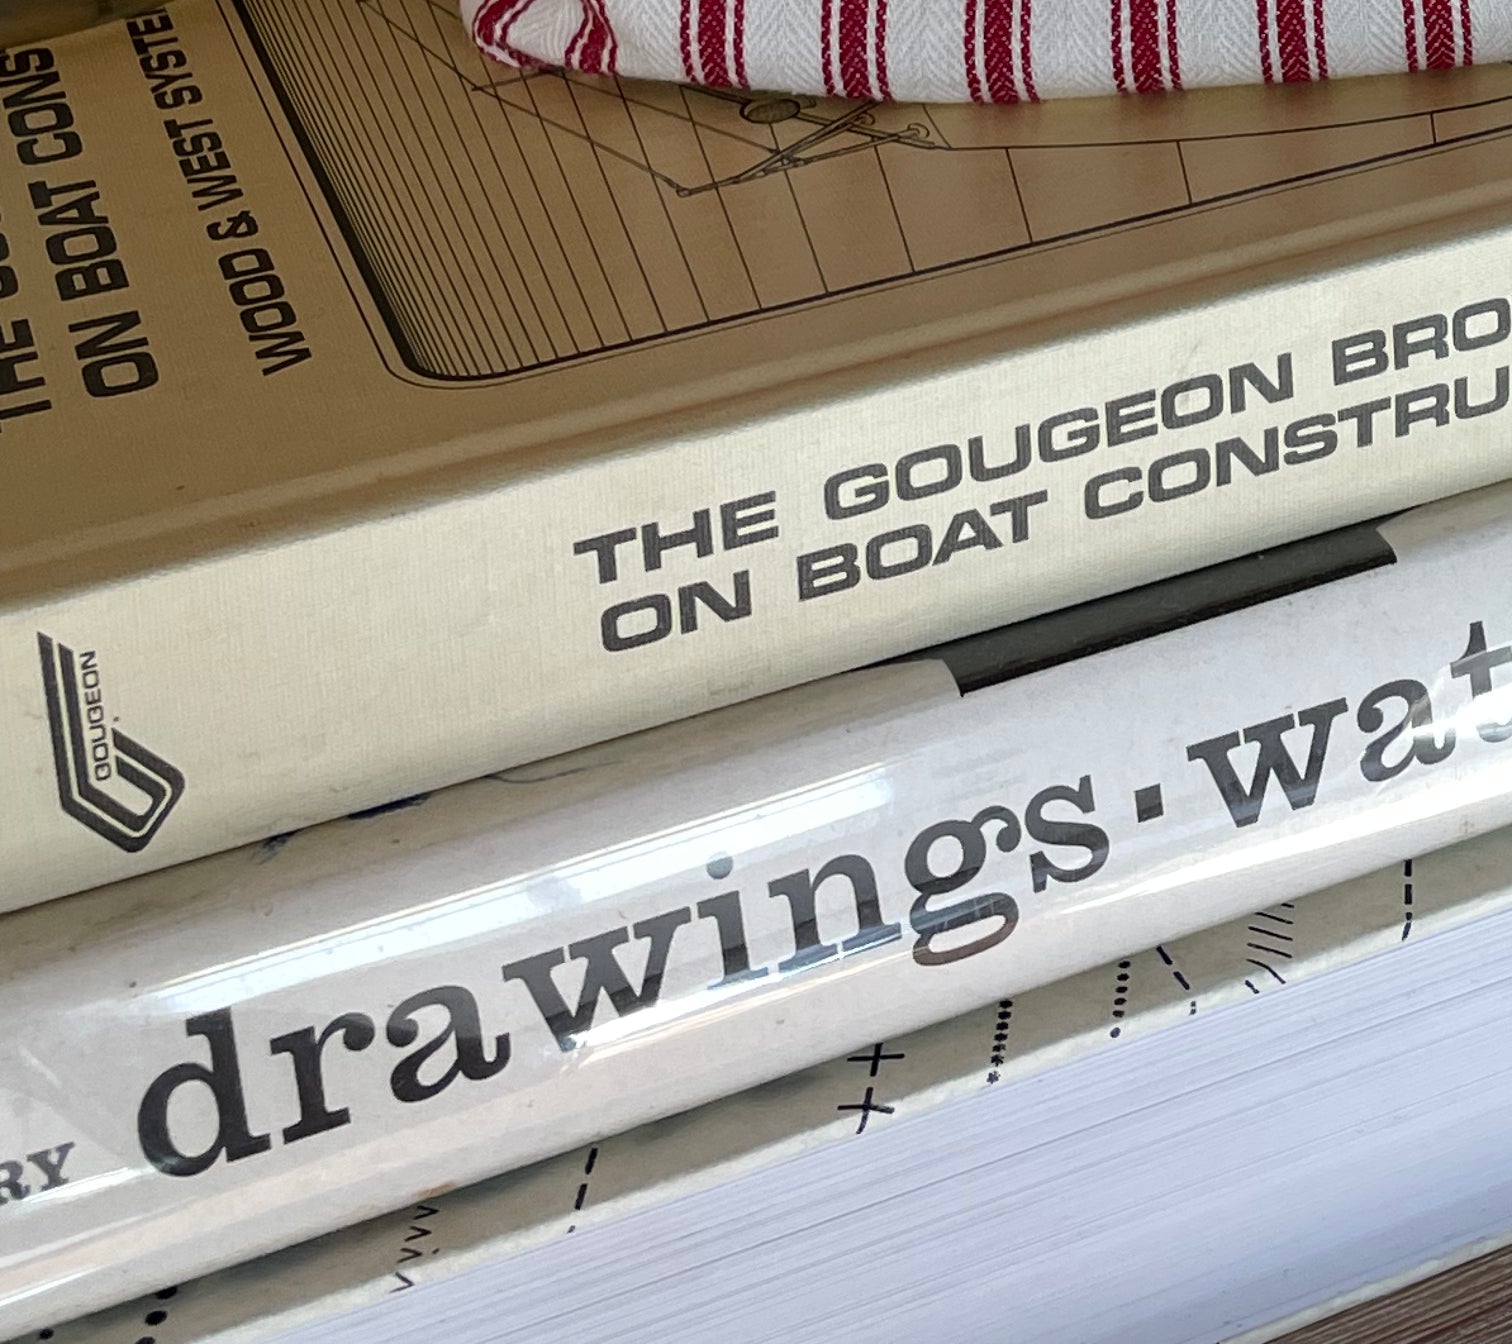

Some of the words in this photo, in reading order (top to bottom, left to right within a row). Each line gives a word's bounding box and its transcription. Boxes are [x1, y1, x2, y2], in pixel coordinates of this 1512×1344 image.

[126, 8, 203, 110] SYSTE
[163, 118, 244, 211] WEST
[206, 209, 259, 241] &
[27, 179, 129, 301] BOAT
[68, 309, 159, 398] ON
[218, 247, 312, 376] WOOD
[573, 490, 780, 584] THE
[822, 352, 1293, 522] GOUGEON
[600, 569, 753, 653] ON
[796, 490, 1049, 602] BOAT
[79, 650, 113, 783] GOUGEON
[137, 775, 1110, 1178] drawings
